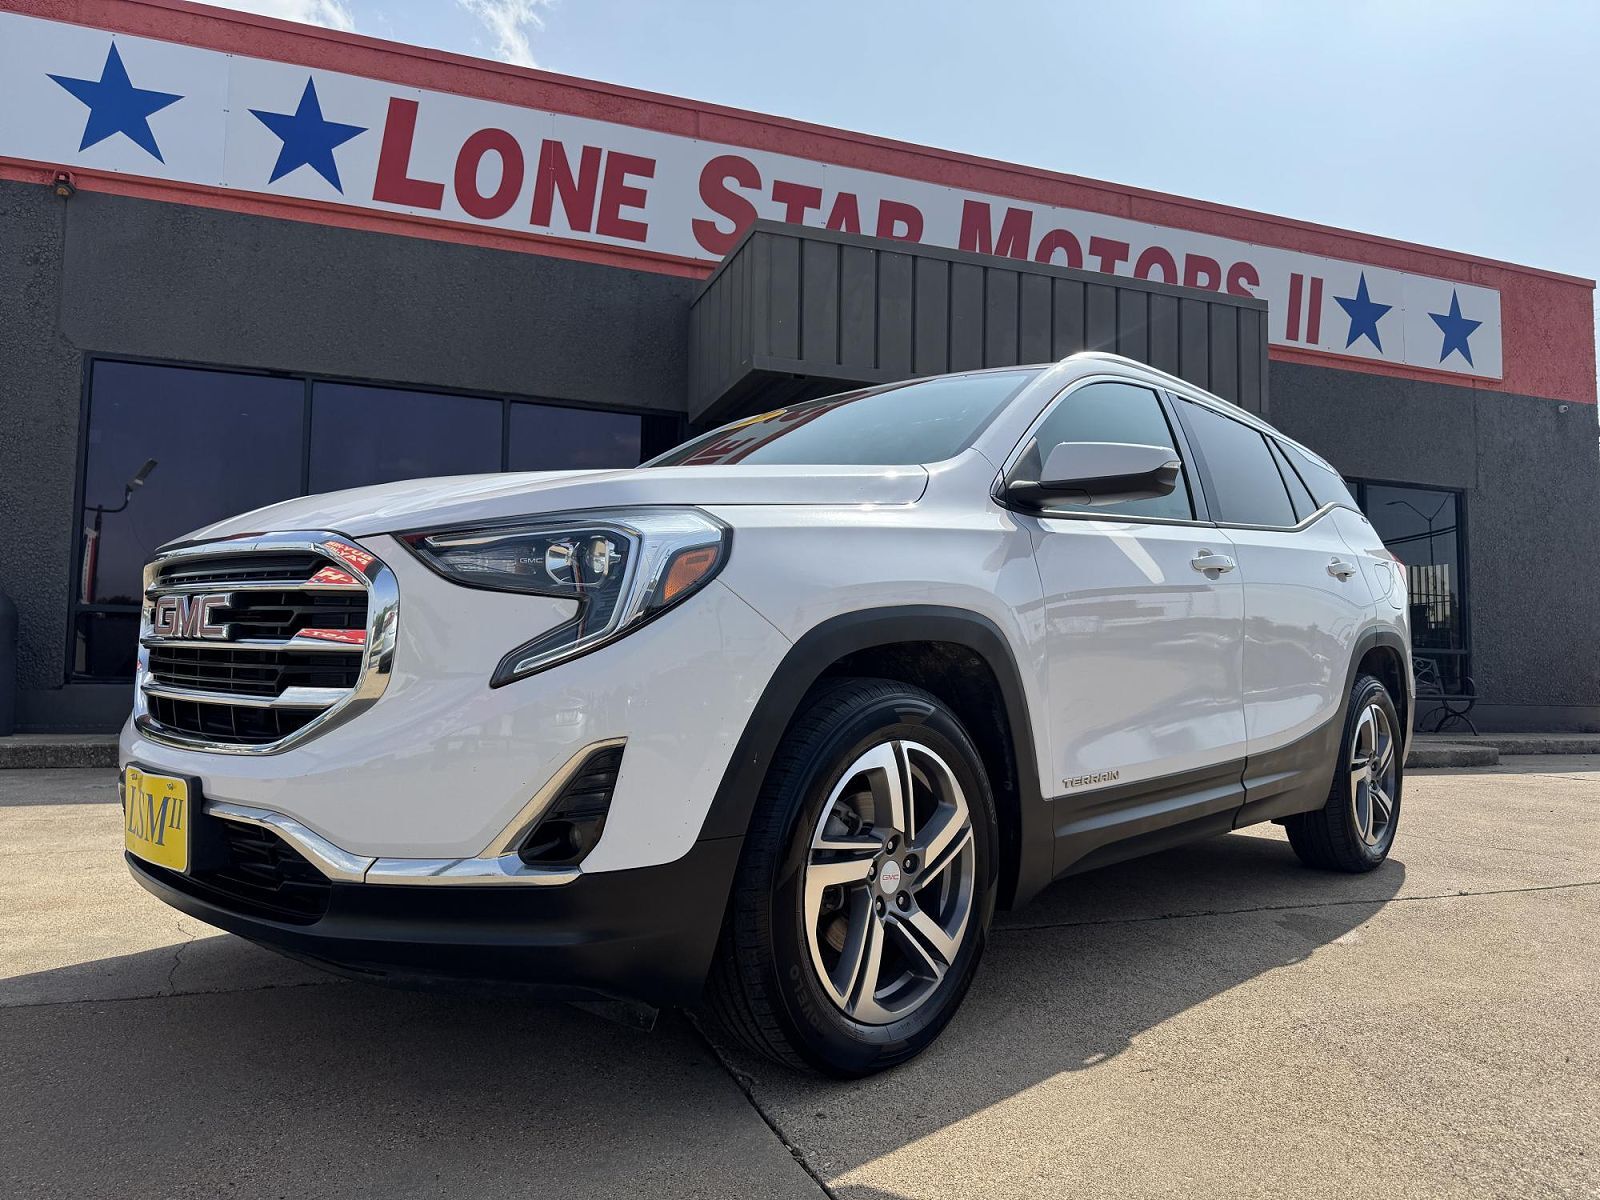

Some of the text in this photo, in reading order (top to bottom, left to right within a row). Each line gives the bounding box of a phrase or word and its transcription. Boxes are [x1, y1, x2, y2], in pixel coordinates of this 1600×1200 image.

[372, 97, 656, 243] LONE
[1285, 272, 1324, 345] II
[154, 593, 233, 640] GMC
[1062, 770, 1119, 788] TERRAIN
[127, 786, 171, 846] LSM
[882, 873, 900, 881] GMC
